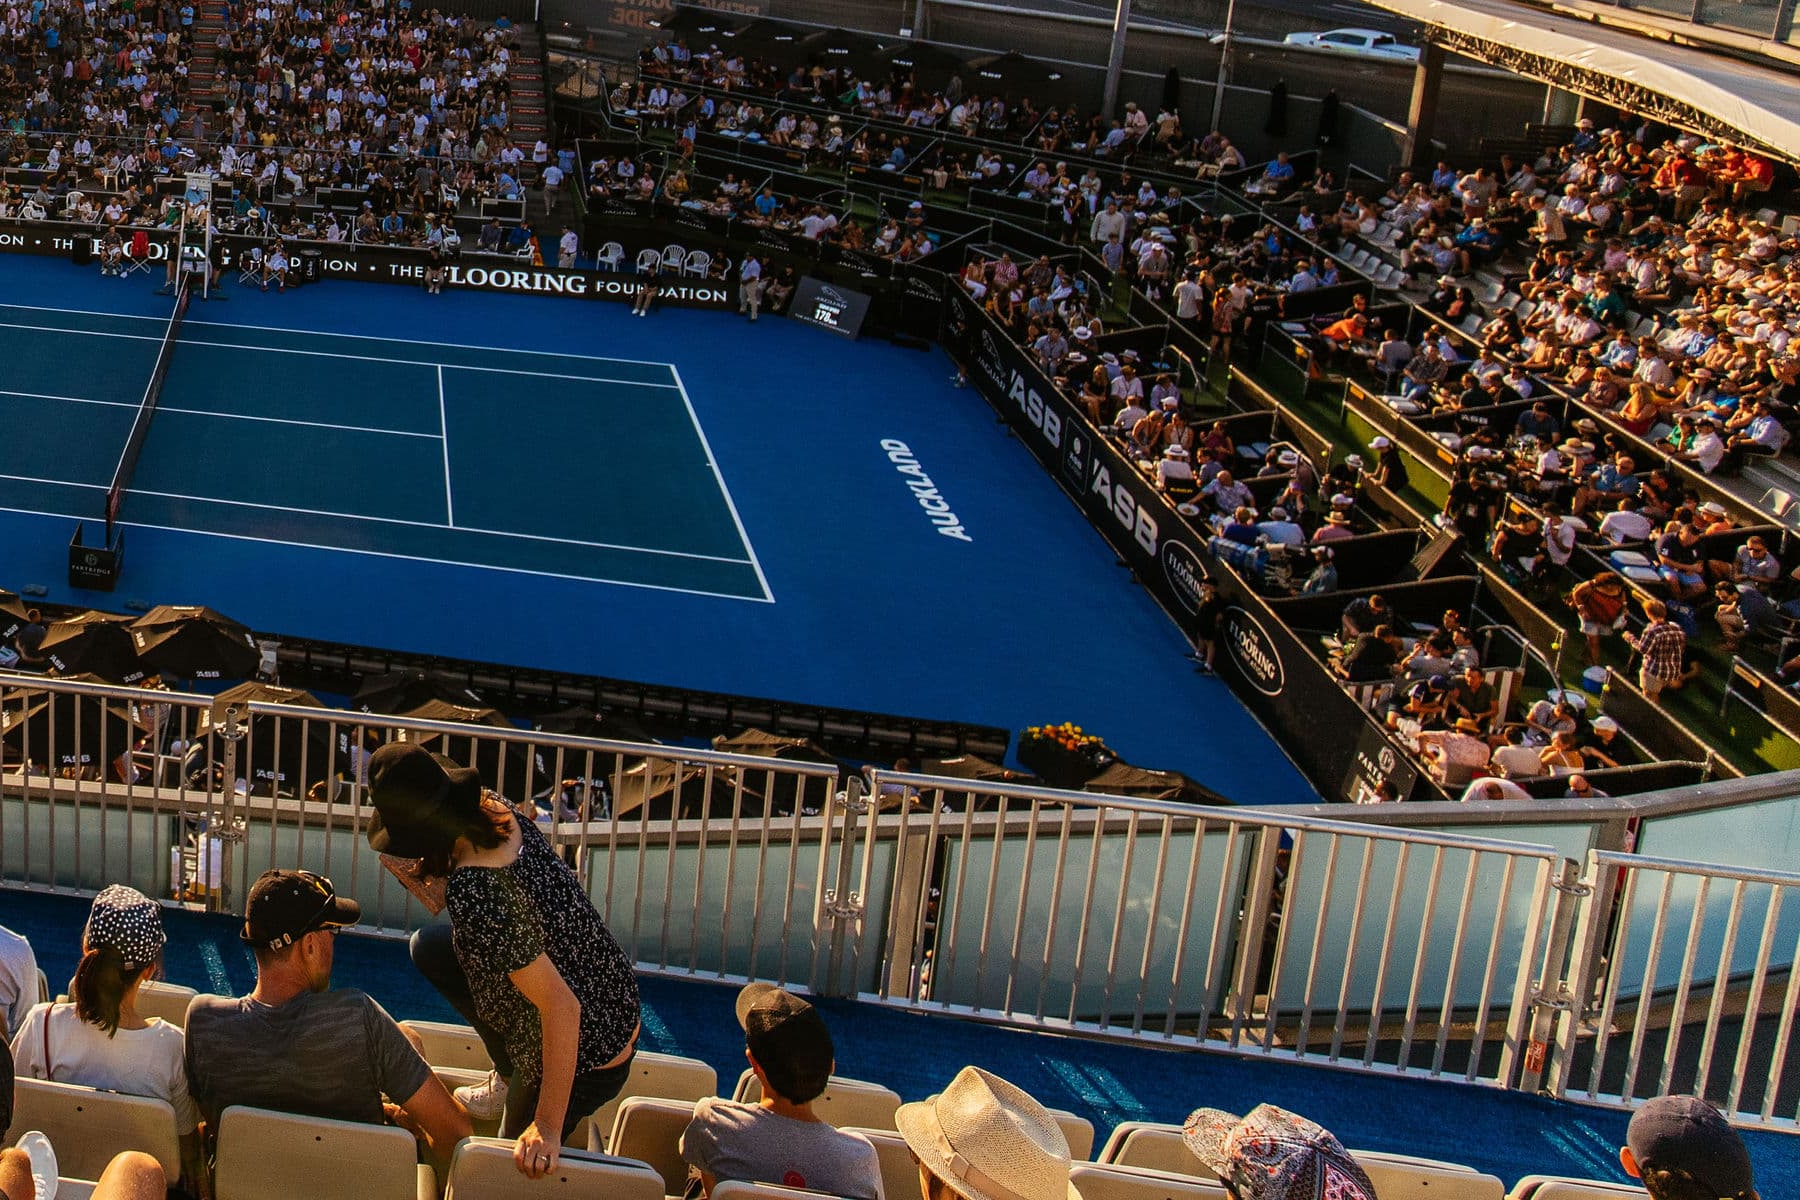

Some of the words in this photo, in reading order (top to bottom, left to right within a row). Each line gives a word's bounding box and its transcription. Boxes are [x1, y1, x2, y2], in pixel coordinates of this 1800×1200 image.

[675, 219, 706, 230] JAGUAR
[756, 240, 790, 252] JAGUAR
[389, 263, 423, 278] THE
[444, 266, 587, 294] LOORING
[596, 280, 728, 302] FOUATION
[838, 260, 874, 274] JAGUAR
[815, 296, 847, 309] JAGUAR
[905, 287, 942, 303] JAGUAR
[977, 356, 1006, 392] JAGUAR
[1008, 369, 1061, 448] ASB
[880, 439, 973, 542] AUCKLAND
[1092, 458, 1158, 556] ASB
[1229, 621, 1276, 680] FLOORING
